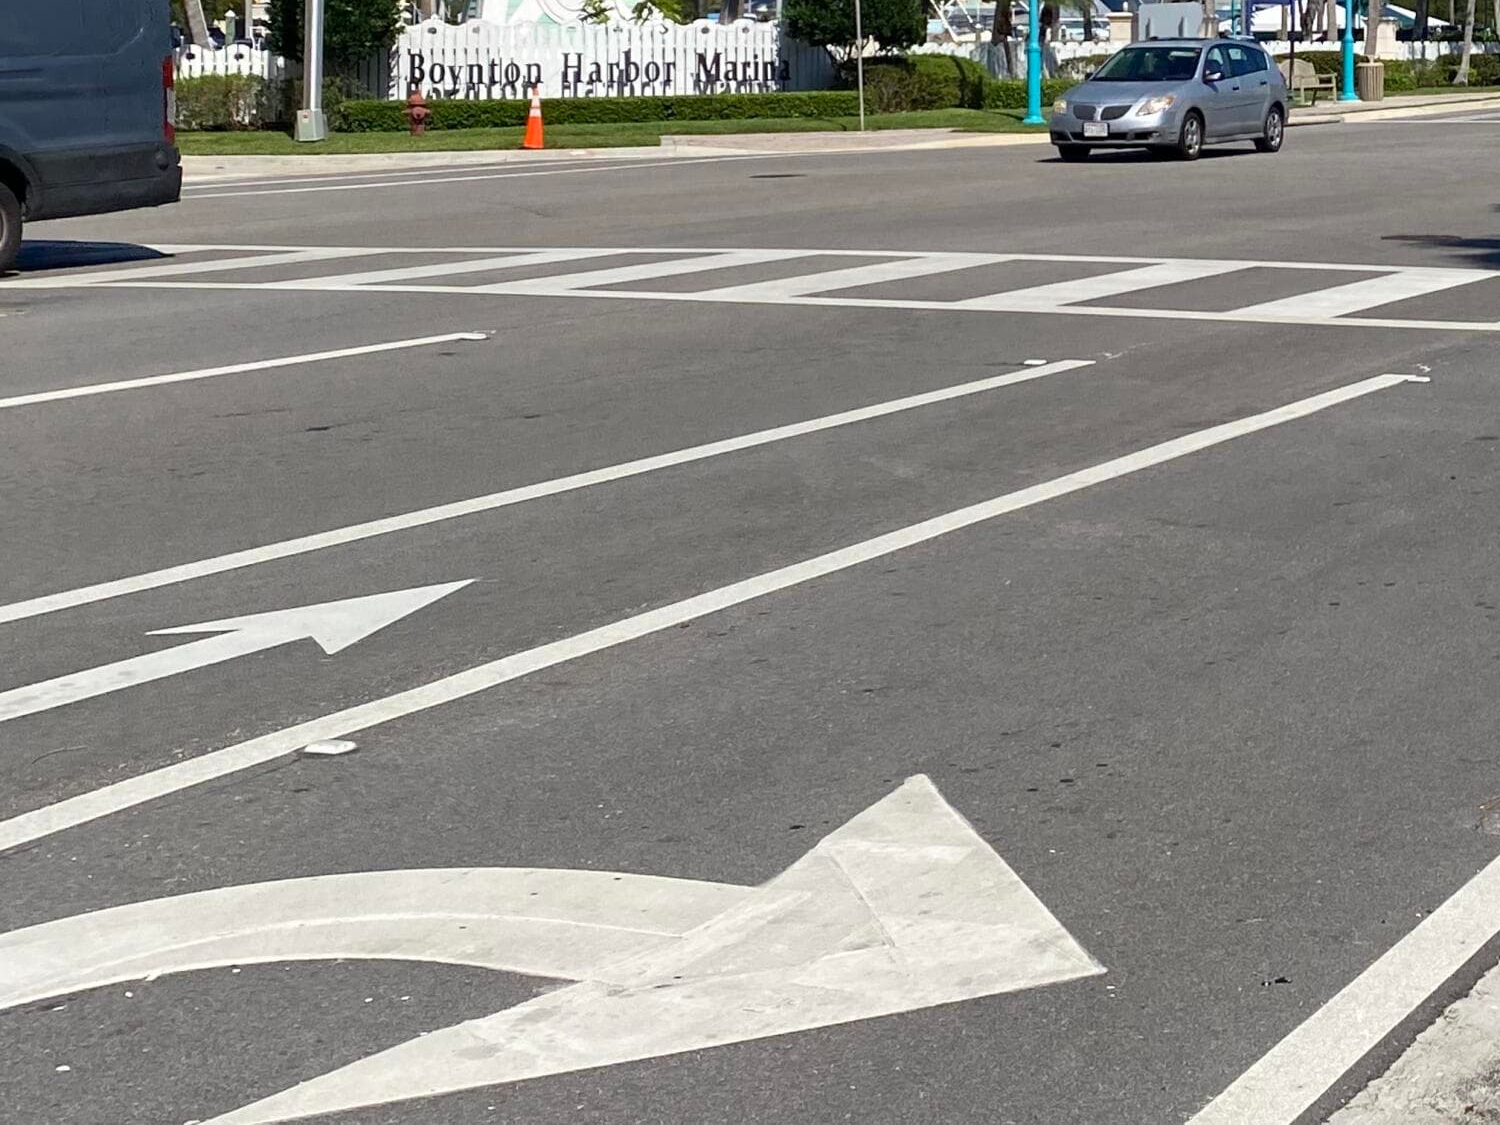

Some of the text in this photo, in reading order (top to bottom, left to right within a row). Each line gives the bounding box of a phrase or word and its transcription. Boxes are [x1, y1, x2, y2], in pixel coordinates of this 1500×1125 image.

[409, 48, 791, 91] Boynton Harbor Marina
